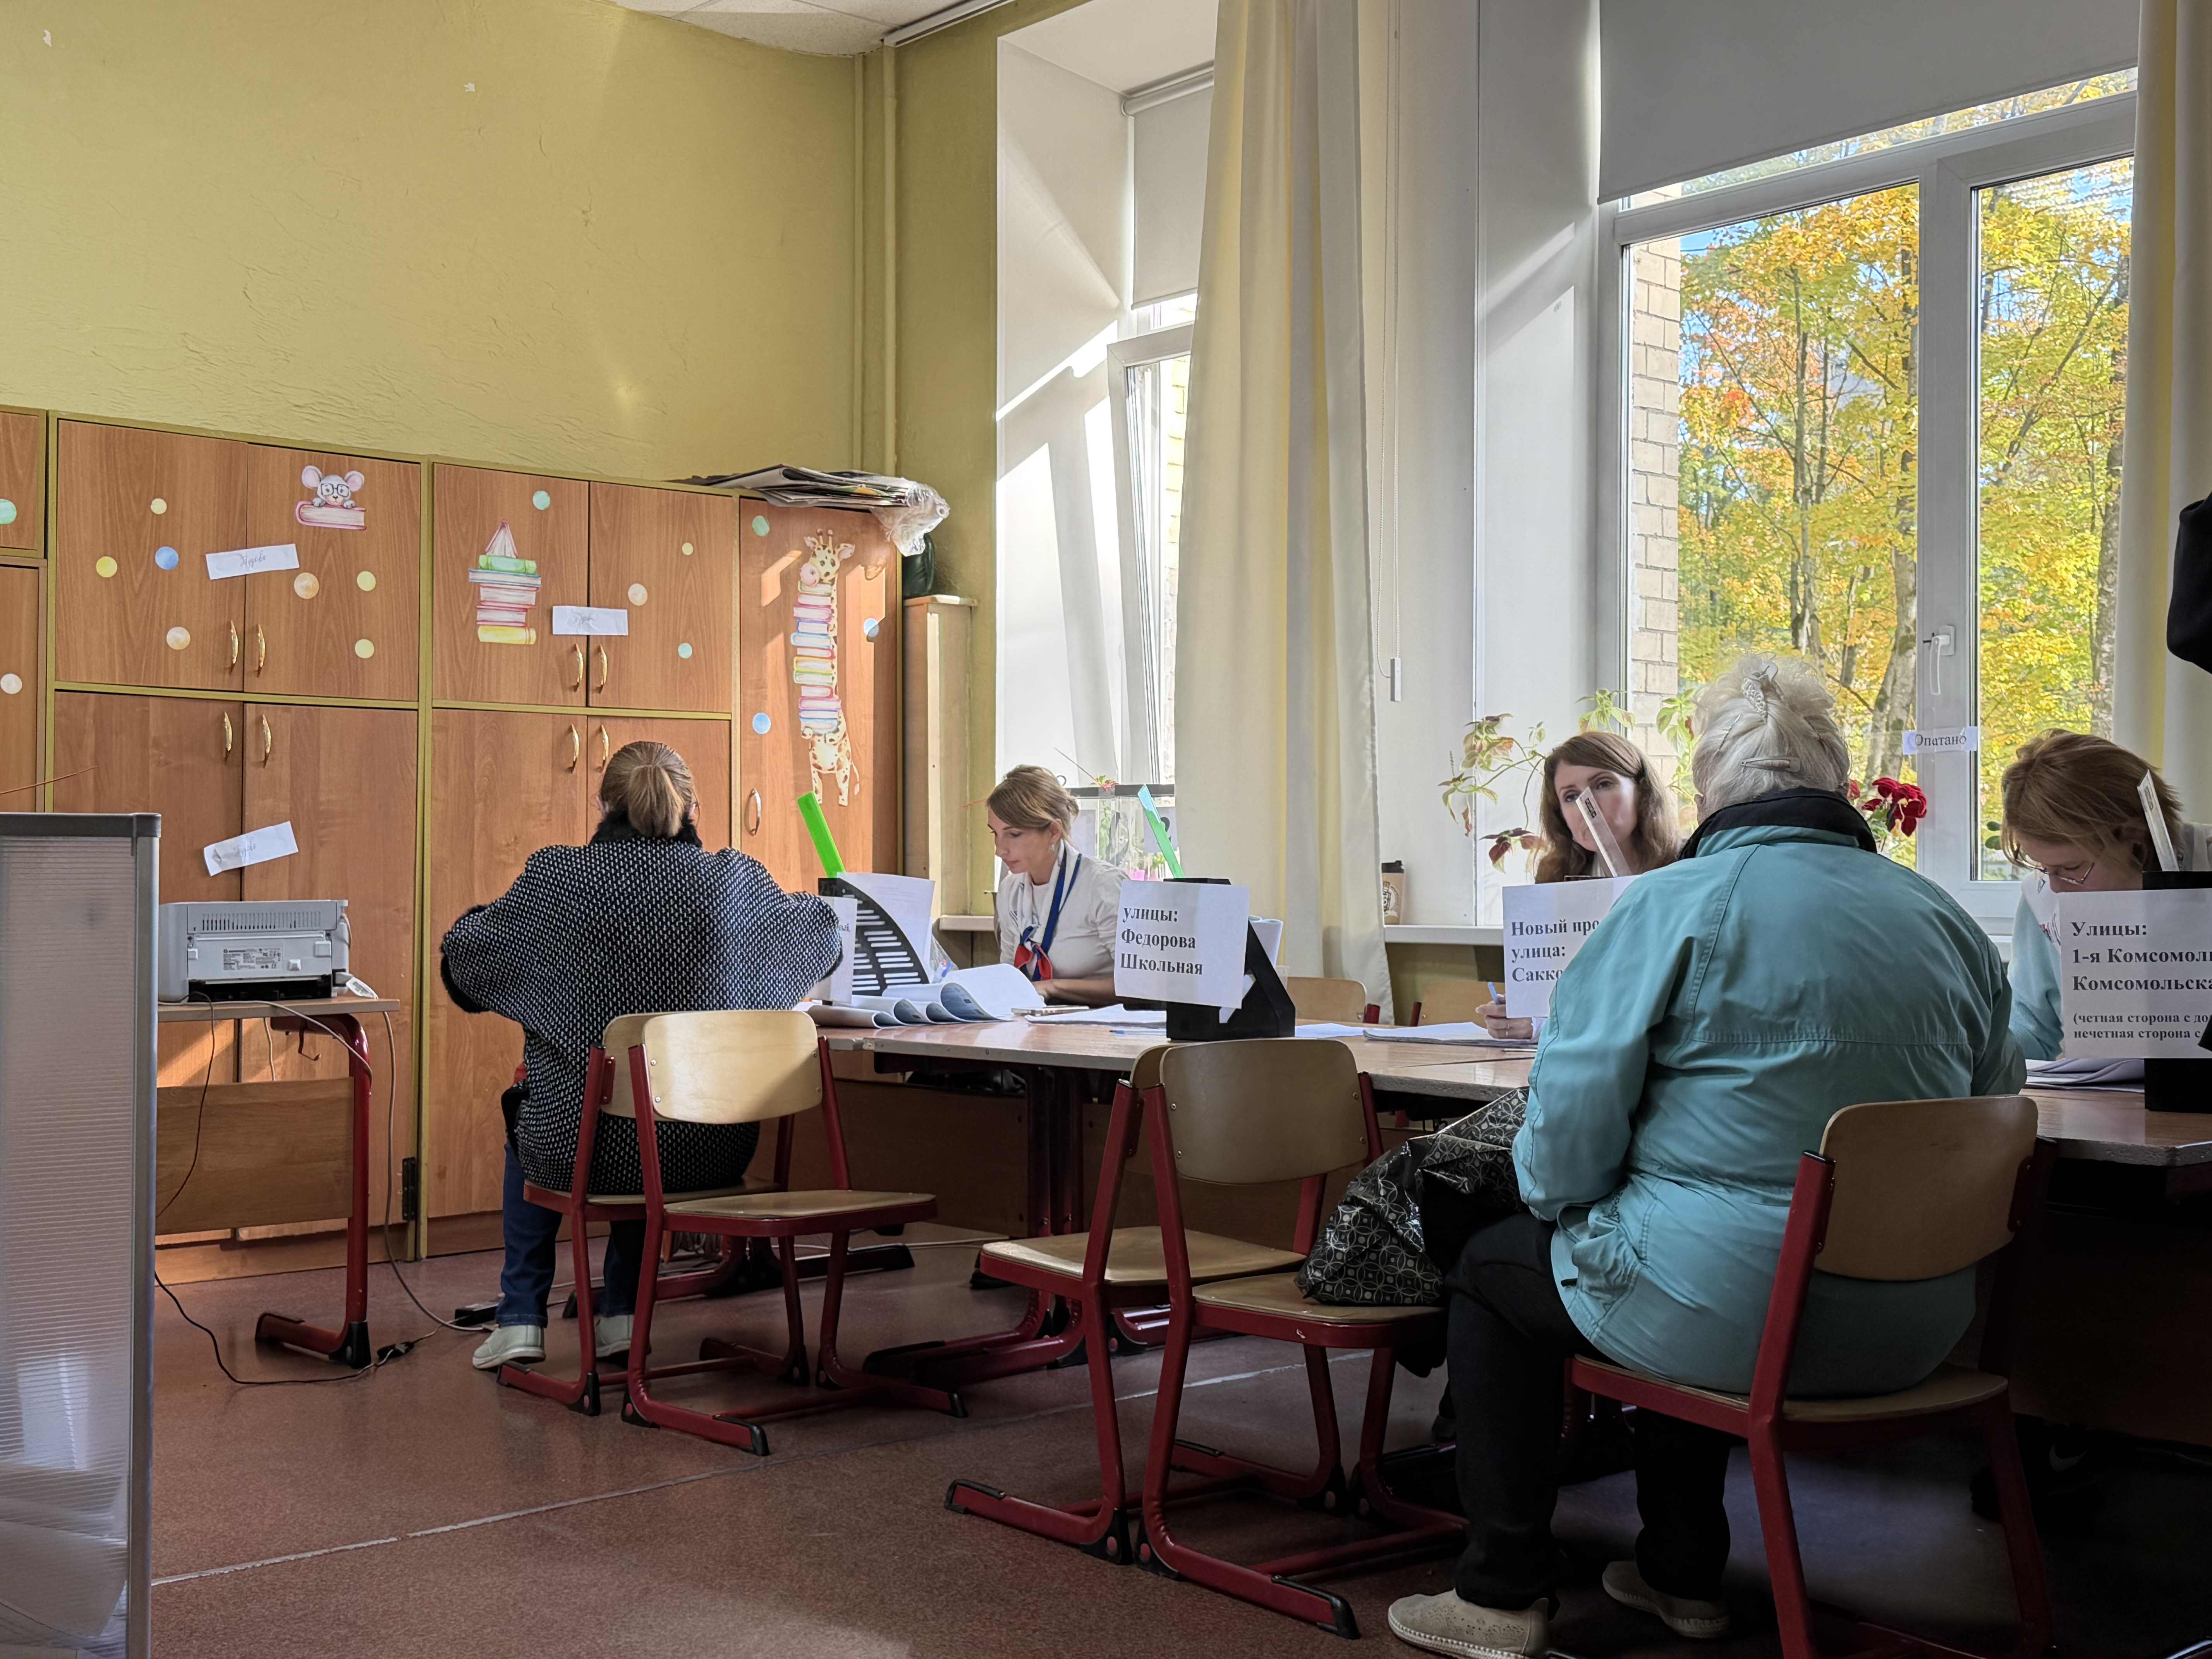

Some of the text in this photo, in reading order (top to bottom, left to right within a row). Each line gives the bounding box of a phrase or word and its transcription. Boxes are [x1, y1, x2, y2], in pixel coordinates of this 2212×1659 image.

[1122, 907, 1178, 922] улицы:
[1511, 919, 1599, 936] Новый про
[2070, 921, 2147, 937] Улицы:
[1121, 928, 1196, 951] Федорова
[1511, 946, 1565, 963] улица:
[2073, 949, 2100, 963] 1-я
[1120, 953, 1203, 975] Школьная
[1512, 967, 1563, 982] Сакко
[2073, 1013, 2211, 1025] (четная сторона с до
[2074, 1030, 2134, 1038] нечетная
[2138, 1030, 2190, 1041] сторона
